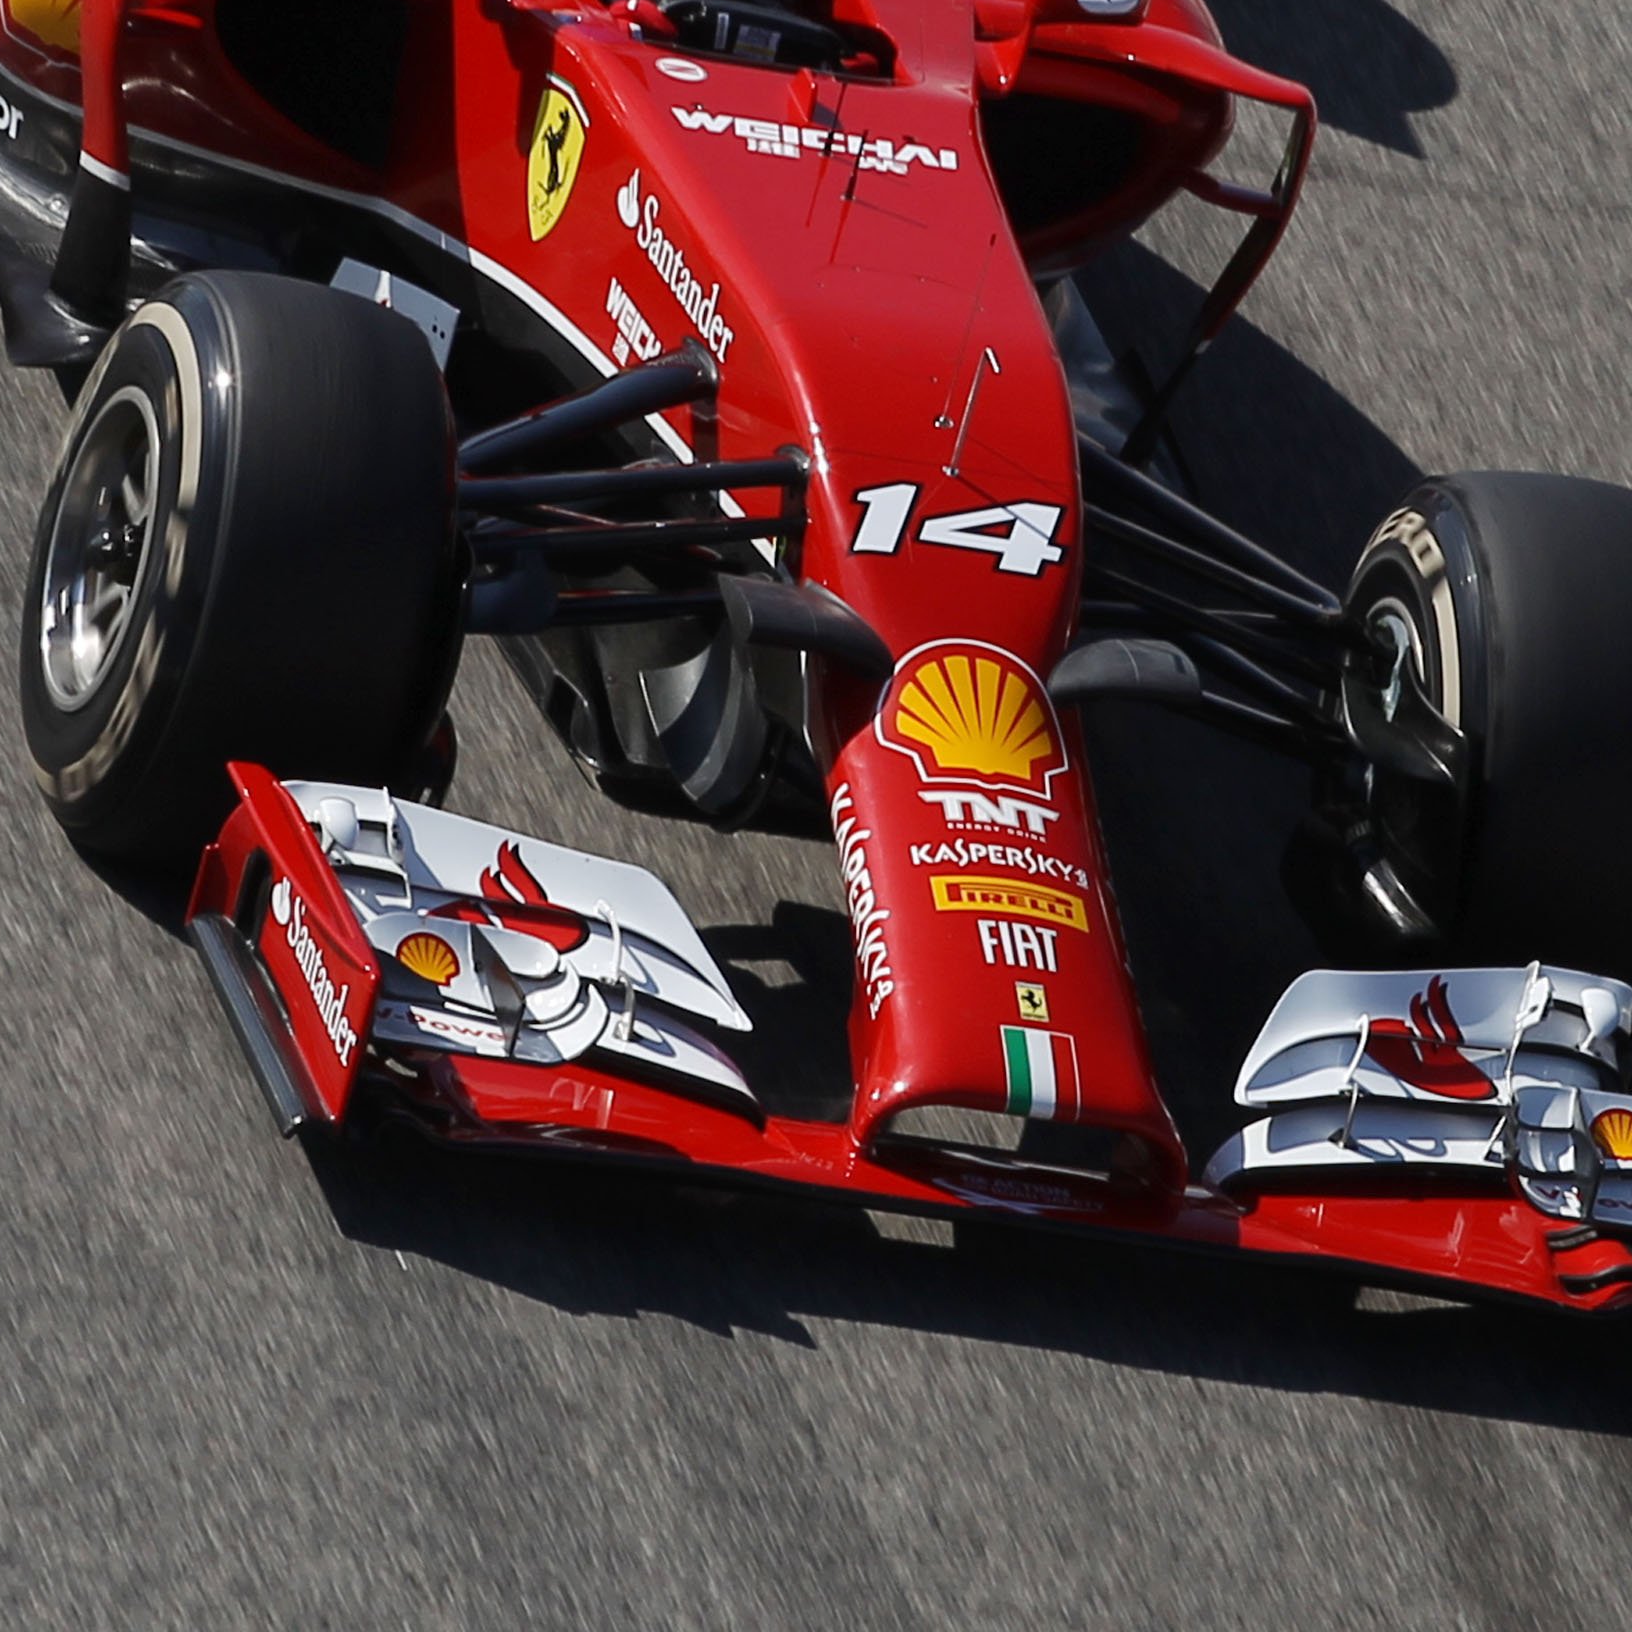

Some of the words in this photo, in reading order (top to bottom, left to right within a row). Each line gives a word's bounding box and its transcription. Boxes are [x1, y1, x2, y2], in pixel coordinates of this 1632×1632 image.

[671, 106, 958, 170] WEICHAI
[637, 194, 734, 364] Santander
[852, 483, 1062, 575] 14
[917, 790, 1060, 835] TNT
[909, 838, 1074, 882] KASPERSKY
[945, 882, 1074, 920] PIRELLI
[977, 919, 1057, 973] FIAT
[287, 896, 359, 1067] Santander
